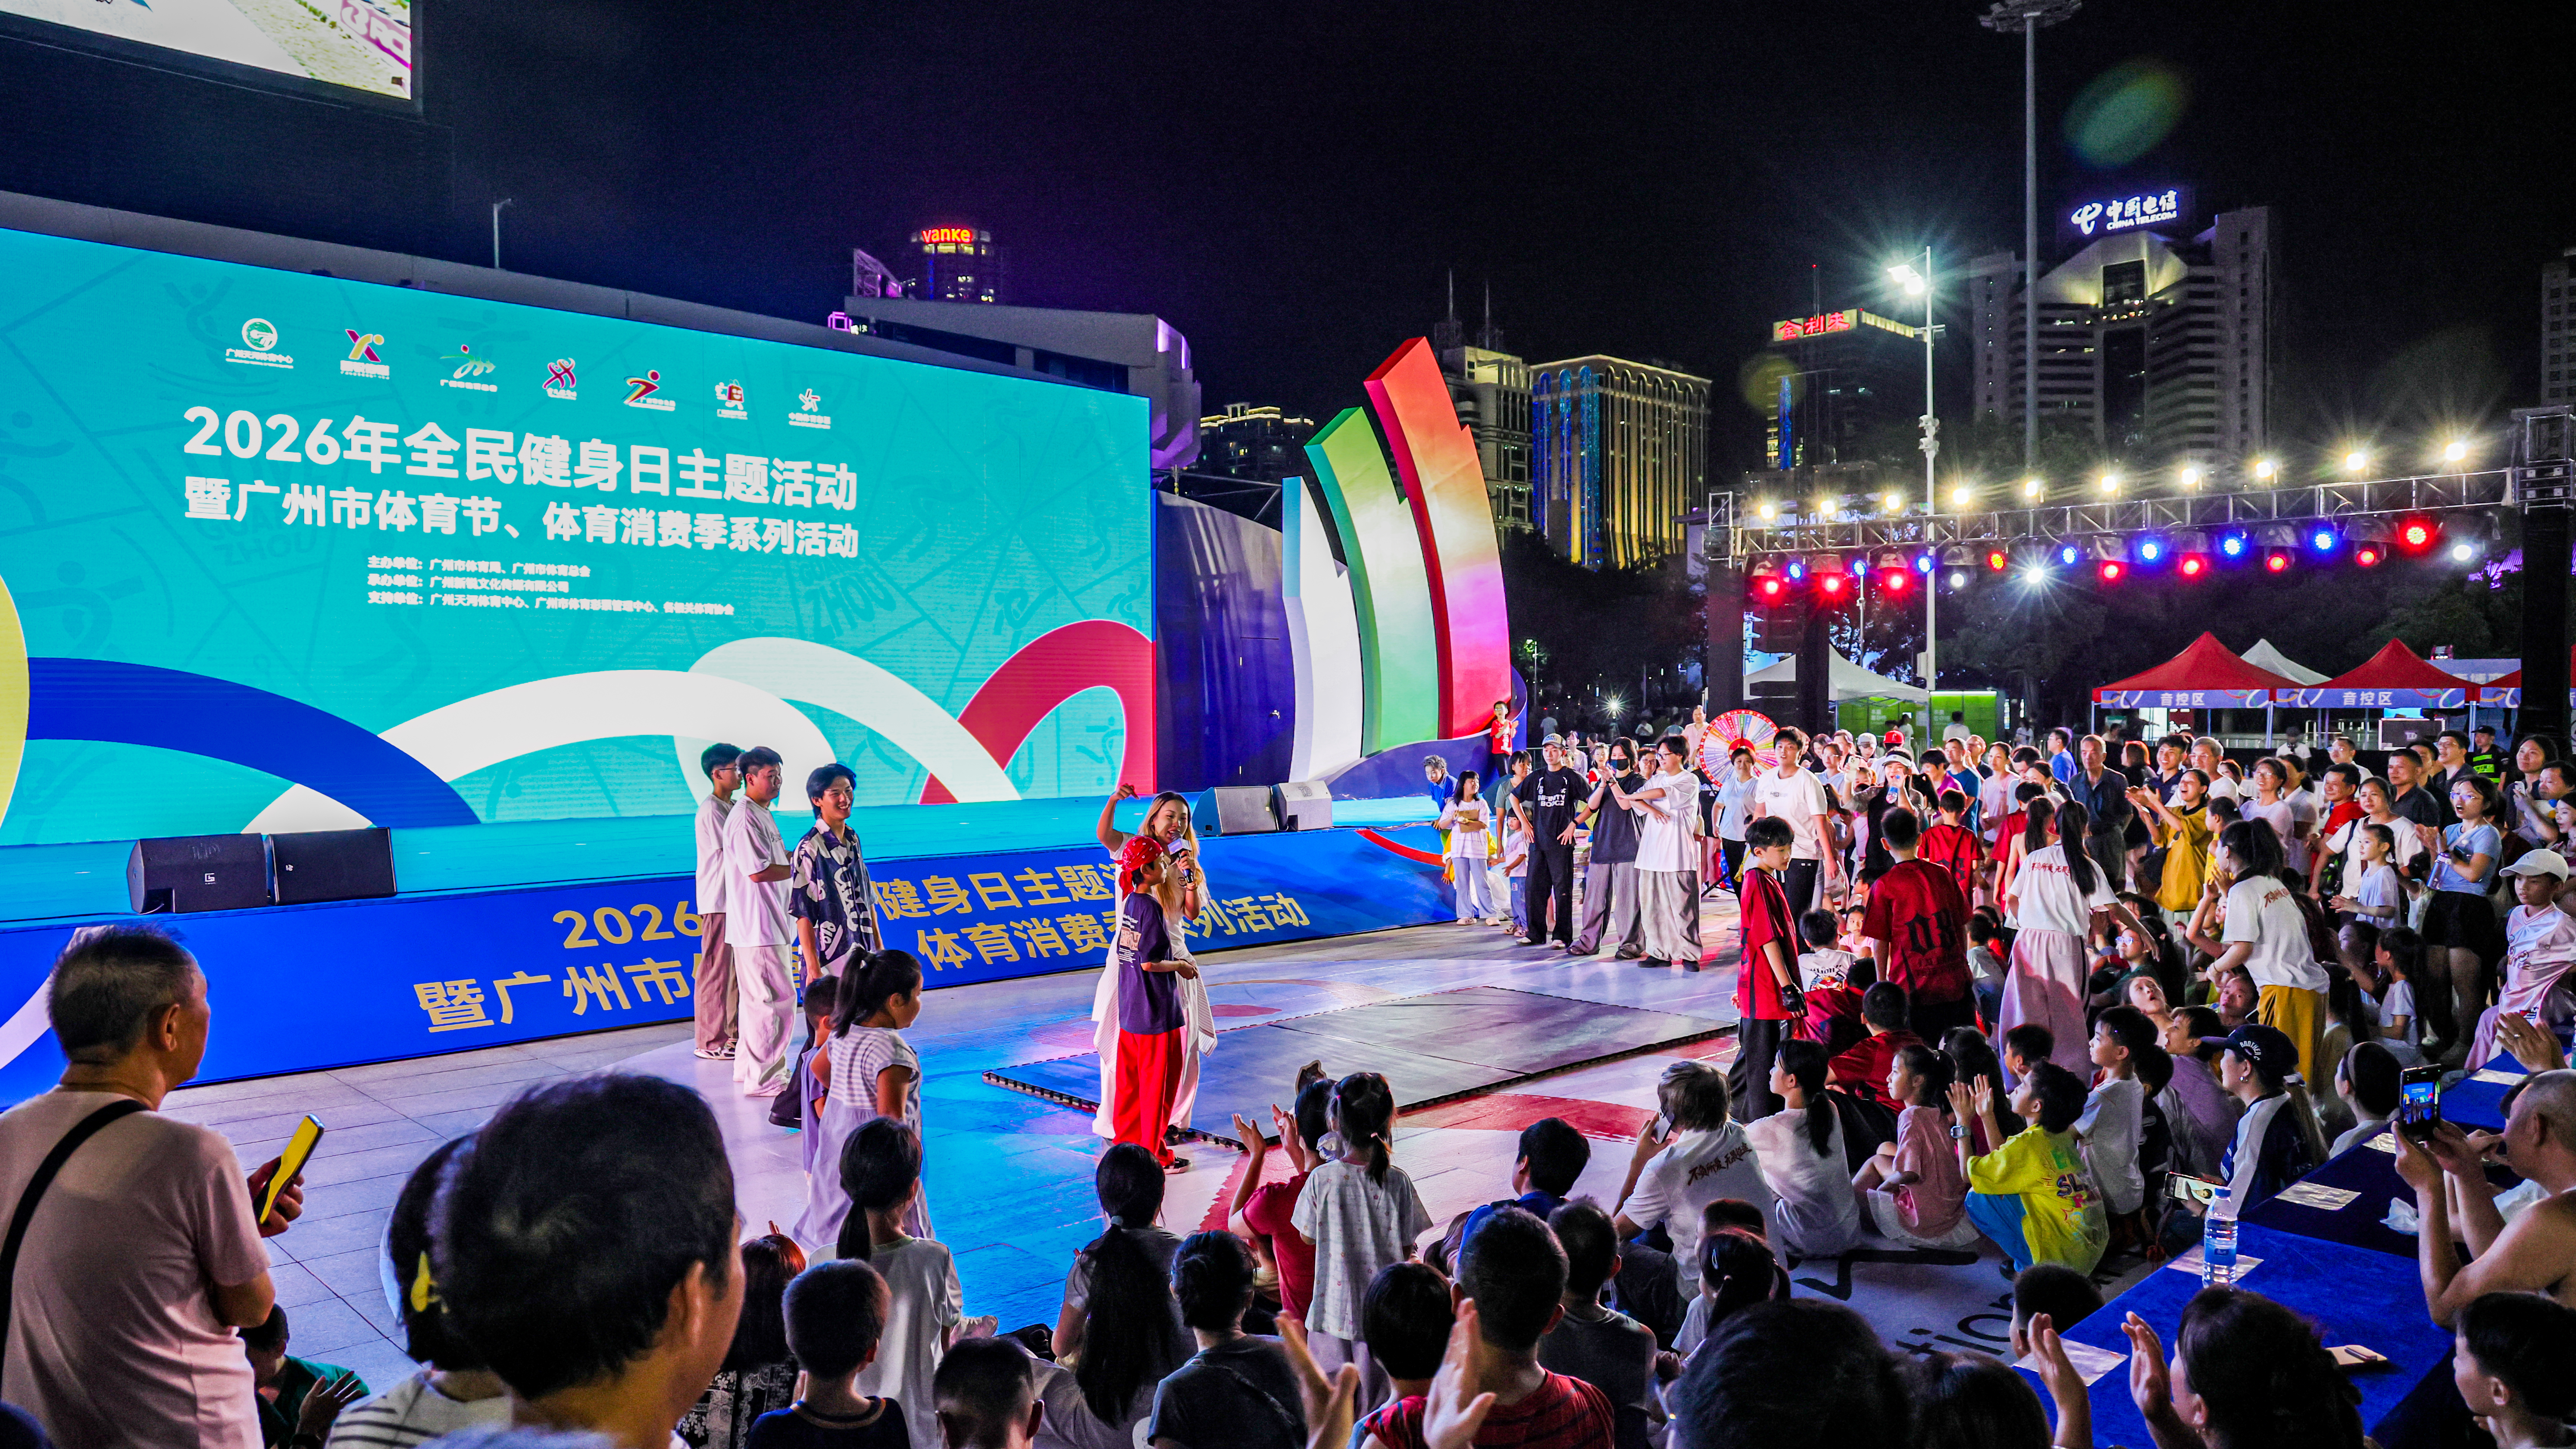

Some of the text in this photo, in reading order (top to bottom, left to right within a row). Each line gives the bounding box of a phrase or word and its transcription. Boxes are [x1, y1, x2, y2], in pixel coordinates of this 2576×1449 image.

[2106, 190, 2177, 222] 中国电信
[2106, 210, 2177, 231] CHINA TELECOM
[184, 406, 857, 511] 2026年全民健身日主题活动
[184, 476, 859, 558] 暨广州市体育节、体育消费季系列活动
[2160, 692, 2205, 707] 音控区
[2342, 691, 2393, 706] 音控区
